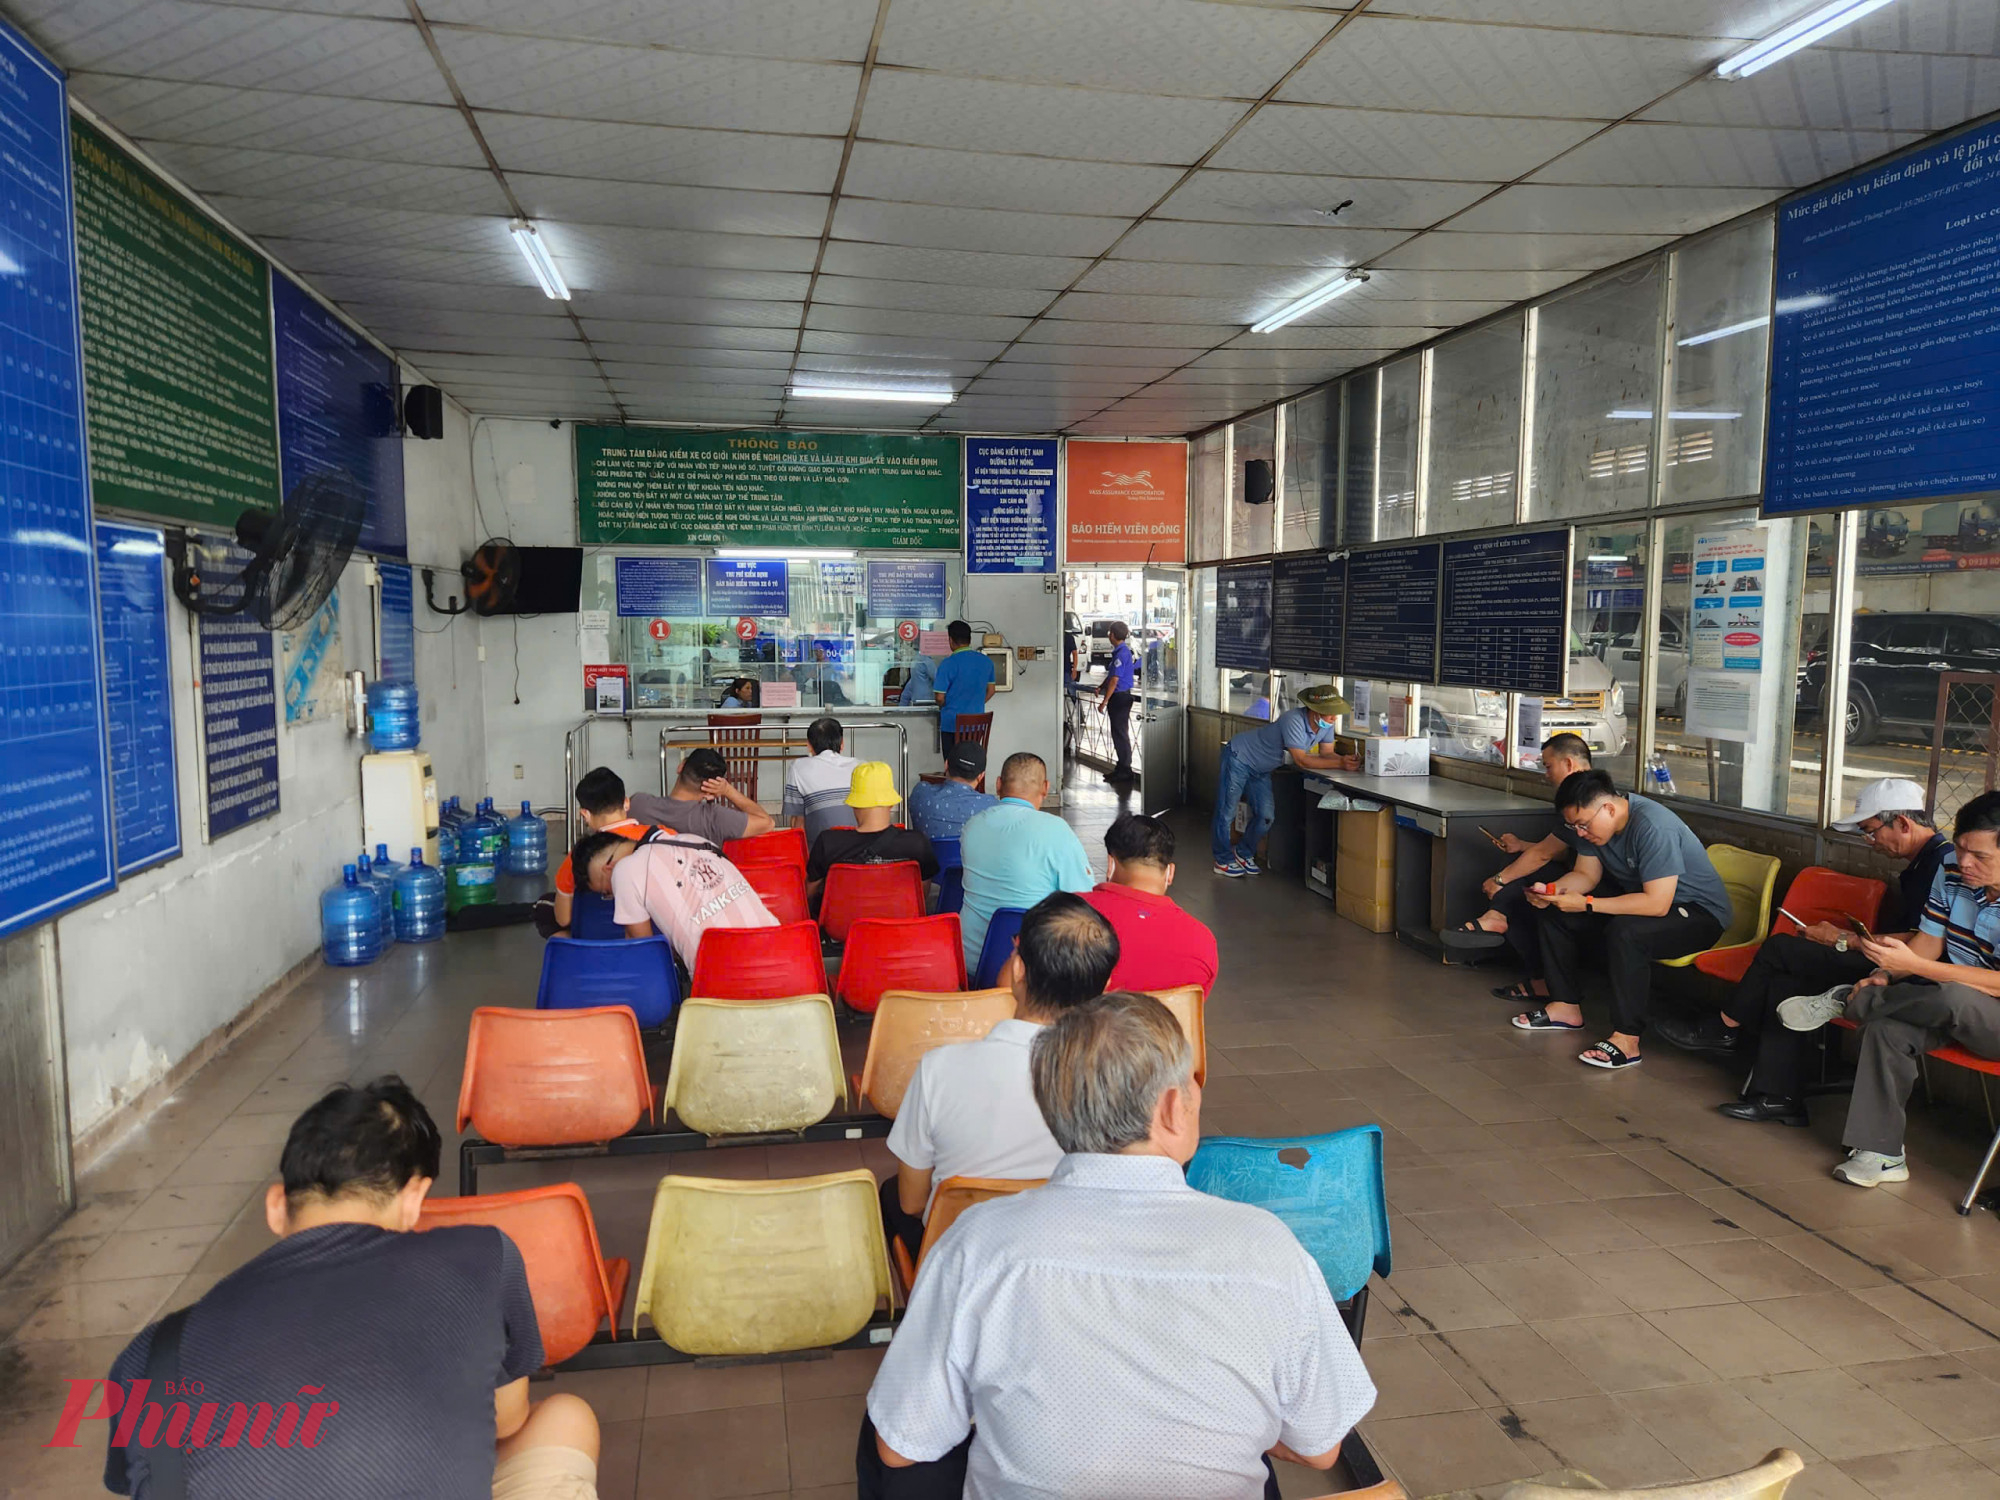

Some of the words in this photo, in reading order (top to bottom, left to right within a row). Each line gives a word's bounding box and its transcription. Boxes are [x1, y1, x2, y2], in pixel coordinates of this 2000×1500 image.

[1963, 153, 1982, 173] đối
[1788, 206, 1810, 221] Mức
[1812, 197, 1828, 214] giá
[1831, 188, 1853, 205] dịch
[1857, 183, 1869, 195] vụ
[1873, 170, 1900, 189] kiểm
[1904, 159, 1930, 178] định
[1936, 151, 1949, 166] và
[1954, 144, 1964, 160] lệ
[1968, 134, 1990, 157] phí
[1946, 215, 1970, 230] Loại
[1974, 212, 1987, 222] xe
[1964, 379, 1984, 389] buýt
[728, 437, 779, 450] THÔNG
[787, 438, 818, 450] BÁO
[601, 448, 627, 458] TRUNG
[630, 448, 645, 458] TÂM
[670, 447, 688, 458] KIỂM
[690, 451, 699, 459] XE
[732, 450, 750, 460] KÍNH
[782, 452, 798, 462] CHỦ
[799, 454, 808, 462] XE
[810, 453, 820, 462] VÀ
[822, 454, 833, 462] LÁI
[834, 455, 844, 463] XE
[876, 456, 885, 464] XE
[887, 456, 900, 464] VÀO
[902, 454, 920, 466] KIỂM
[921, 458, 938, 467] ĐỊNH
[1072, 521, 1092, 534] BẢO
[1096, 522, 1122, 534] HIỂM
[1124, 522, 1149, 535] VIỄN
[1151, 522, 1180, 535] ĐÔNG
[656, 622, 665, 637] 1
[742, 622, 752, 637] 2
[904, 624, 914, 638] 3
[690, 880, 750, 926] YANKEES
